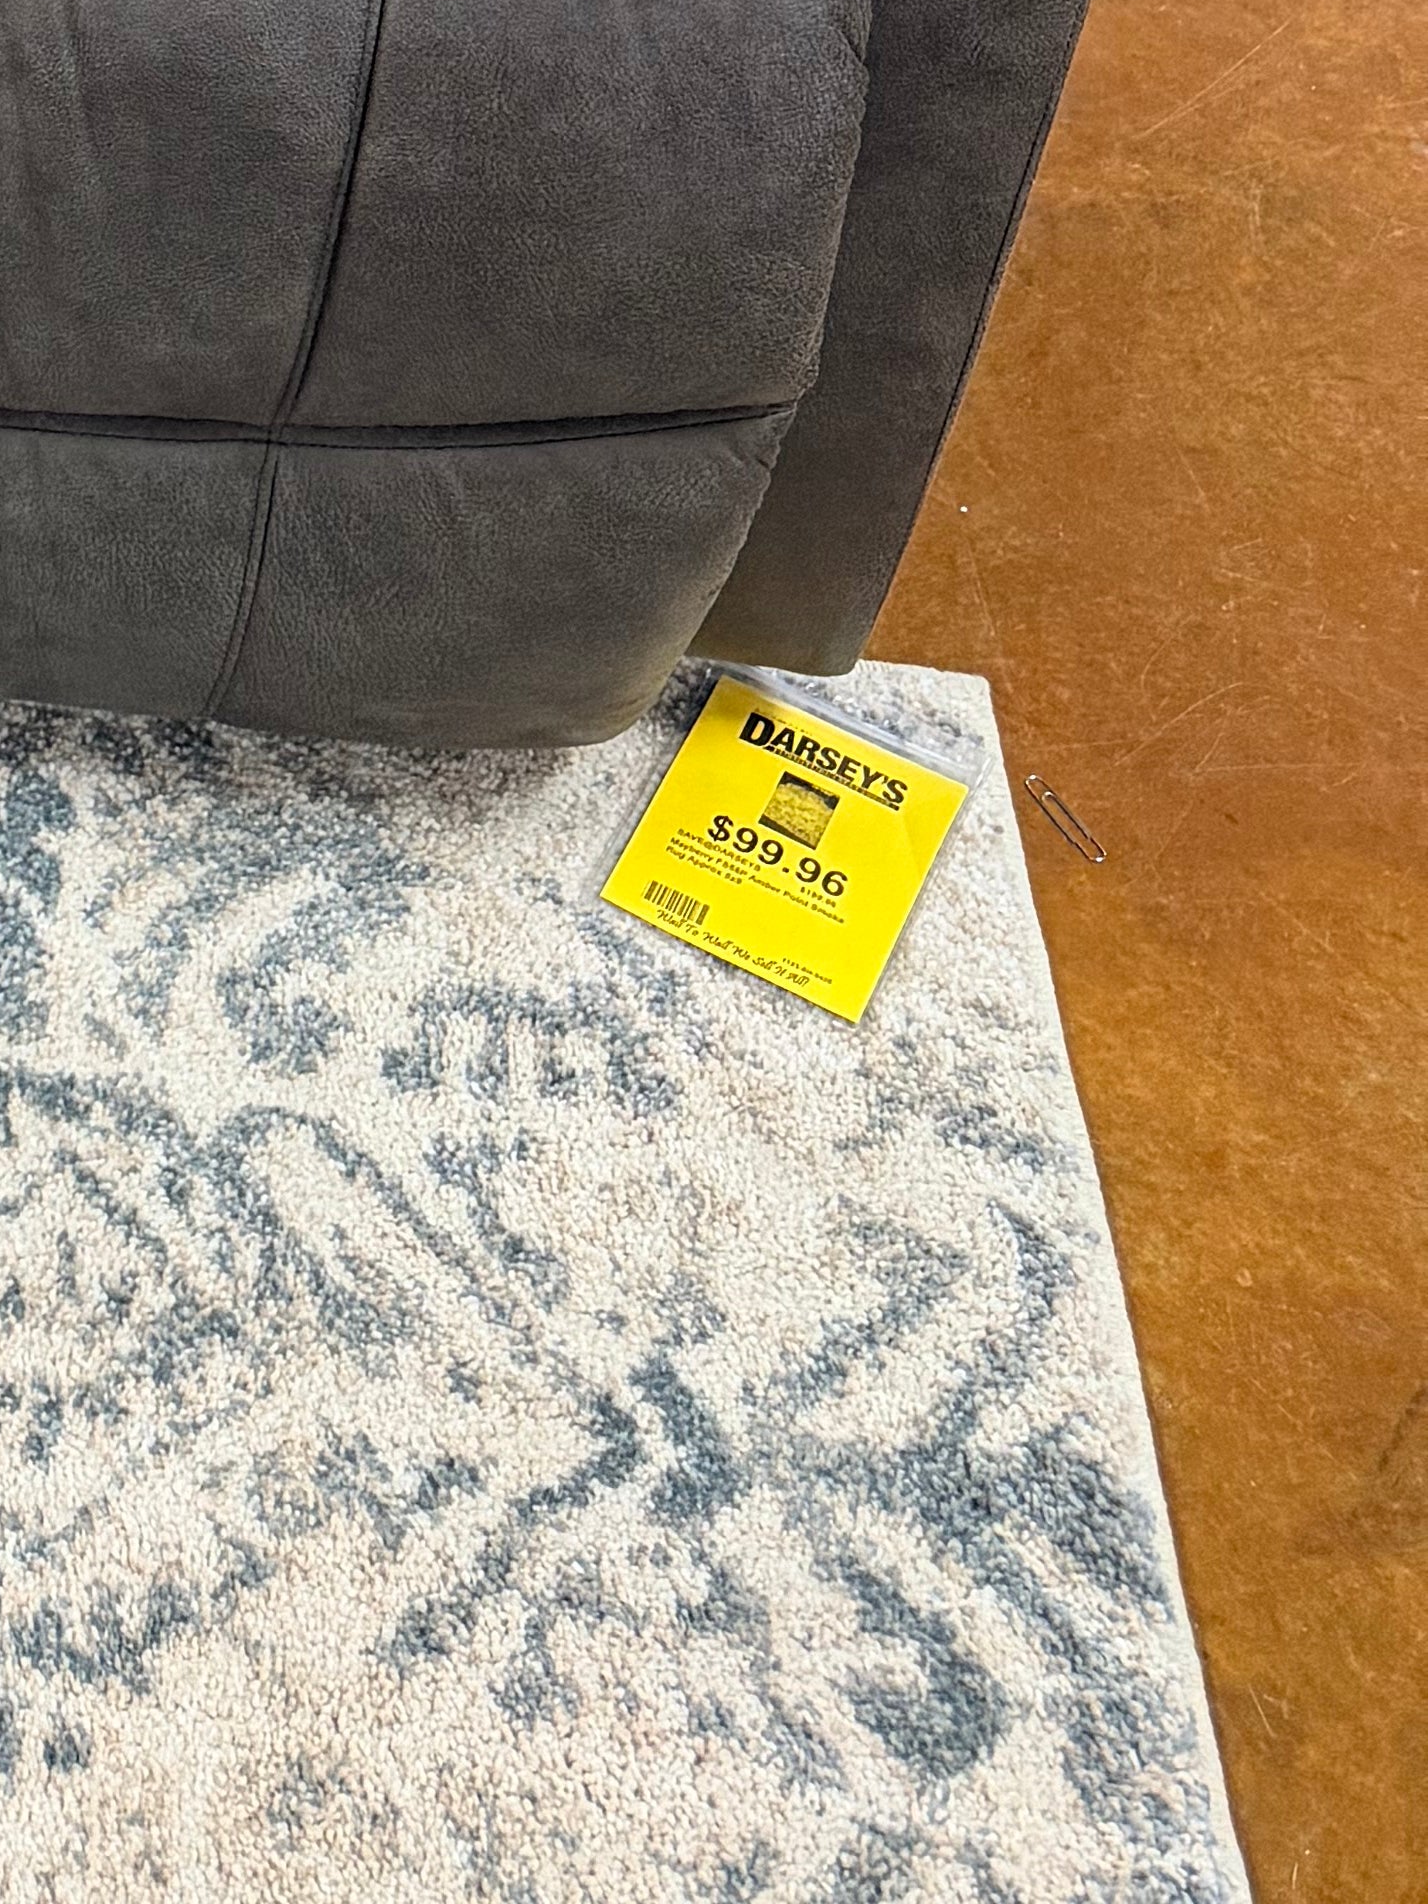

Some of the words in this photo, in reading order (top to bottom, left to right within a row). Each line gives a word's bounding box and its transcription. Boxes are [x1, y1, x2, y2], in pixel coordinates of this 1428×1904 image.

[739, 711, 909, 805] DARSEY'S
[706, 814, 849, 898] $99.96
[654, 907, 687, 930] Wall
[701, 929, 733, 952] Wall
[782, 890, 809, 907] Point
